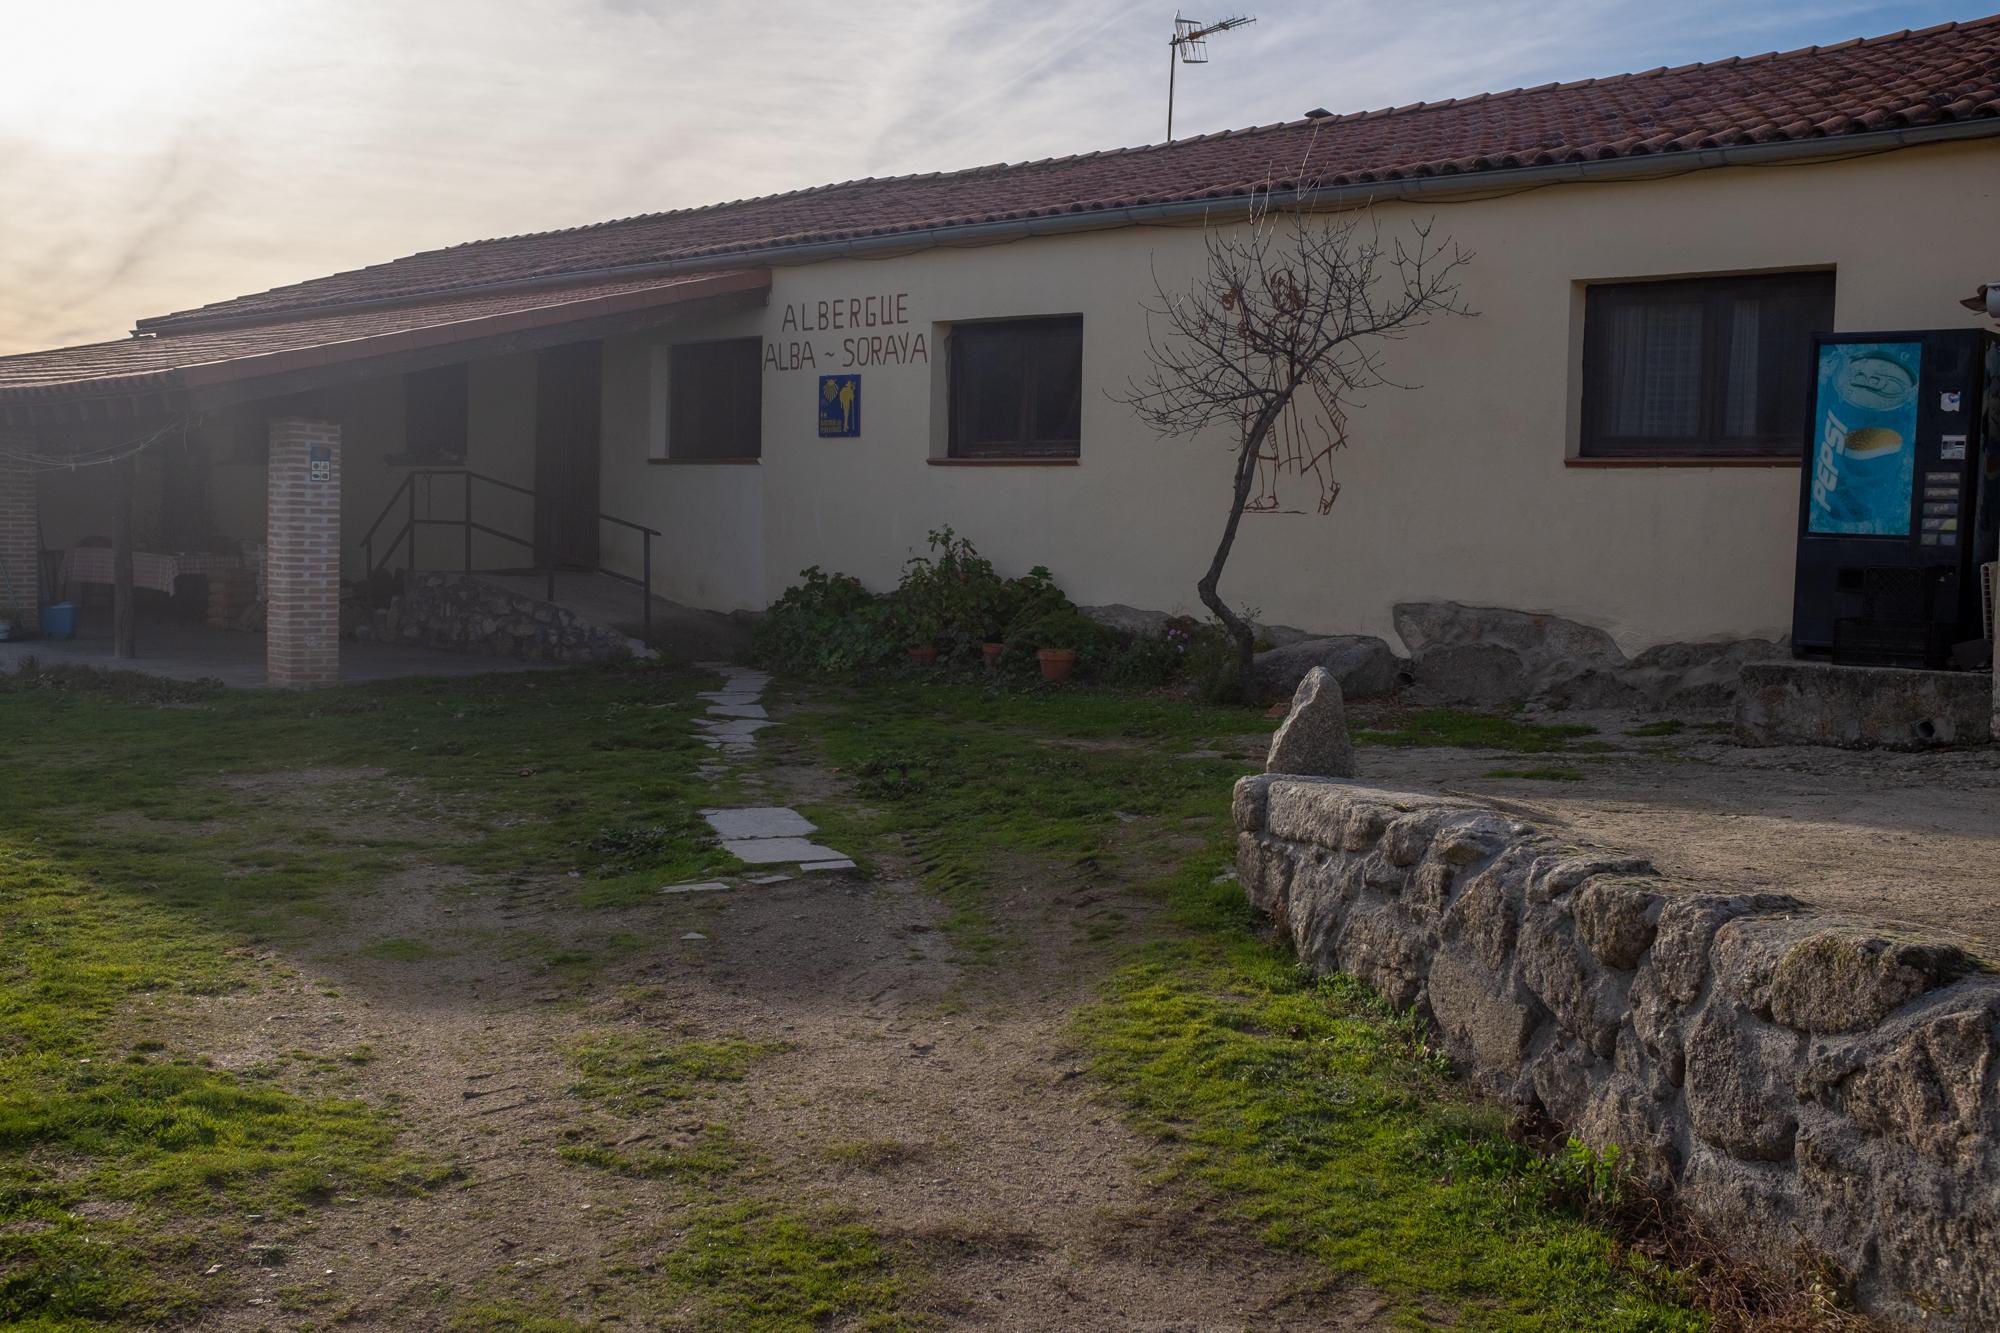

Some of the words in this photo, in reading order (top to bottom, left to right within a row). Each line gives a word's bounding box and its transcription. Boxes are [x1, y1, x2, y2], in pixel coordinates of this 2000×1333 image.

[782, 293, 908, 332] ALBERGUE
[763, 341, 816, 371] ALBA
[842, 332, 928, 367] SORAYA
[1813, 408, 1848, 512] PEPSI
